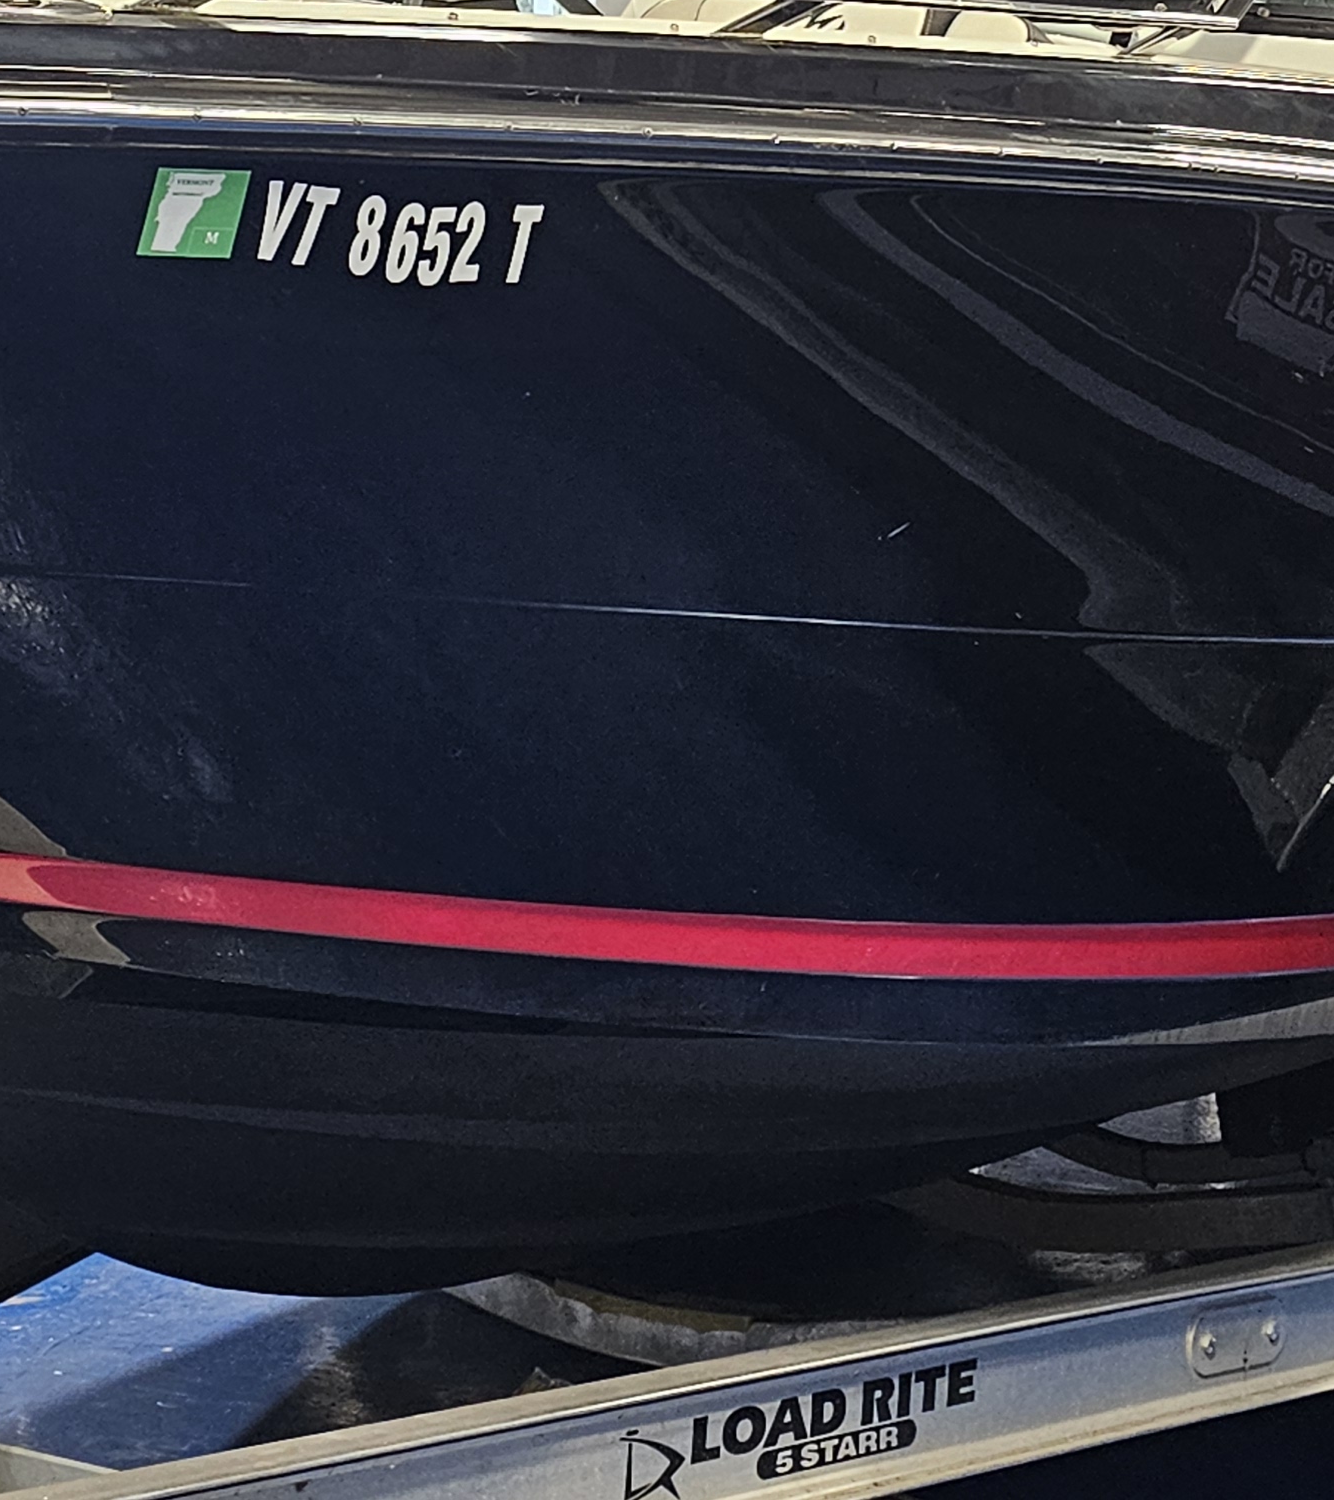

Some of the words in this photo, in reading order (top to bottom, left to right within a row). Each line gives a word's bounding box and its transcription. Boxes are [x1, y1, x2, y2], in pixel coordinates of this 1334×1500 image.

[204, 231, 219, 244] M
[257, 179, 341, 266] VT
[348, 194, 486, 287] 8652
[505, 204, 545, 284] T
[691, 1389, 846, 1464] LOAD
[861, 1359, 978, 1425] RITE
[774, 1446, 794, 1474] 5
[799, 1428, 898, 1466] STARR
